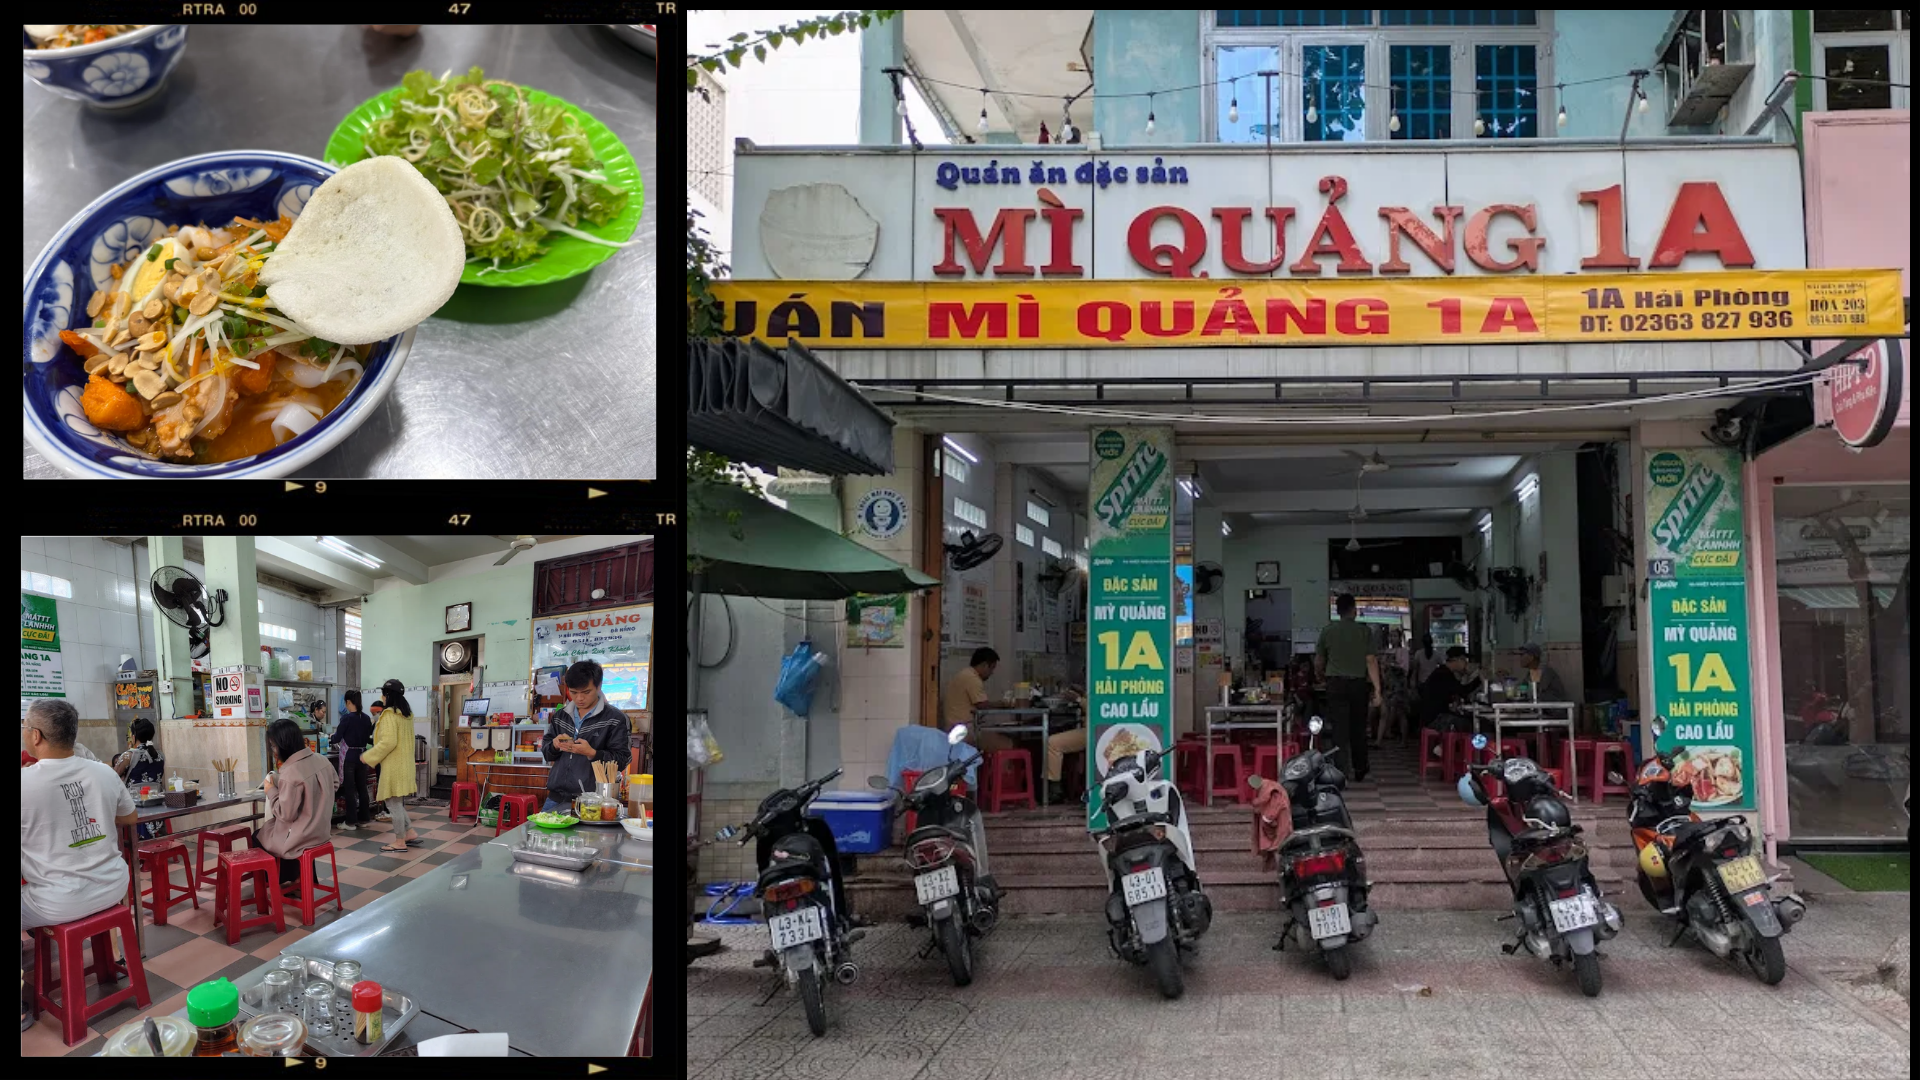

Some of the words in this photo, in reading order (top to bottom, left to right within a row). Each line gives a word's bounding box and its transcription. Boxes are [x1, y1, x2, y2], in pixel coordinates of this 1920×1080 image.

[936, 158, 1021, 190] Quán
[1028, 159, 1067, 185] ăn
[1074, 159, 1129, 190] đặc
[1135, 157, 1189, 185] sản
[933, 187, 1084, 277] MÌ
[1127, 175, 1546, 279] QUẢNG
[1578, 181, 1755, 269] 1A
[1581, 287, 1625, 310] 1A
[1635, 288, 1684, 309] Hải
[1693, 288, 1790, 308] Phòng
[1810, 295, 1838, 312] HÒA
[1842, 298, 1865, 311] 203
[716, 293, 885, 339] UÁN
[928, 293, 1040, 339] MÌ
[1077, 287, 1390, 342] QUẢNG
[1428, 296, 1540, 335] 1A
[1580, 314, 1612, 333] ĐT:
[1620, 312, 1694, 333] 02363
[1701, 311, 1741, 331] 827
[1749, 310, 1794, 329] 936
[1098, 443, 1158, 525] Sprite
[1656, 466, 1714, 549] Sprite
[1654, 560, 1669, 574] 05
[1103, 575, 1128, 594] ĐẶC
[1132, 574, 1158, 592] SẢN
[1094, 603, 1116, 621] MỲ
[1119, 601, 1166, 622] QUẢNG
[1672, 597, 1698, 616] ĐẶC
[1700, 596, 1727, 614] SẢN
[555, 619, 574, 632] MÌ
[578, 613, 641, 631] QUẢNG
[1664, 624, 1686, 642] MỲ
[1689, 622, 1738, 643] QUẢNG
[22, 630, 37, 639] CỰC
[40, 654, 52, 662] 1A
[1098, 630, 1165, 670] 1A
[1668, 653, 1736, 692] 1A
[216, 677, 228, 691] NO
[1095, 676, 1117, 695] HẢI
[1121, 676, 1165, 695] PHÒNG
[215, 694, 242, 705] SMOKING
[1669, 698, 1691, 717] HẢI
[1694, 698, 1739, 717] PHÒNG
[1100, 702, 1129, 719] CAO
[1675, 724, 1703, 741] CAO
[60, 781, 85, 800] IRON
[71, 809, 91, 828] THE
[71, 823, 102, 845] DETAILS
[780, 925, 814, 946] 2334
